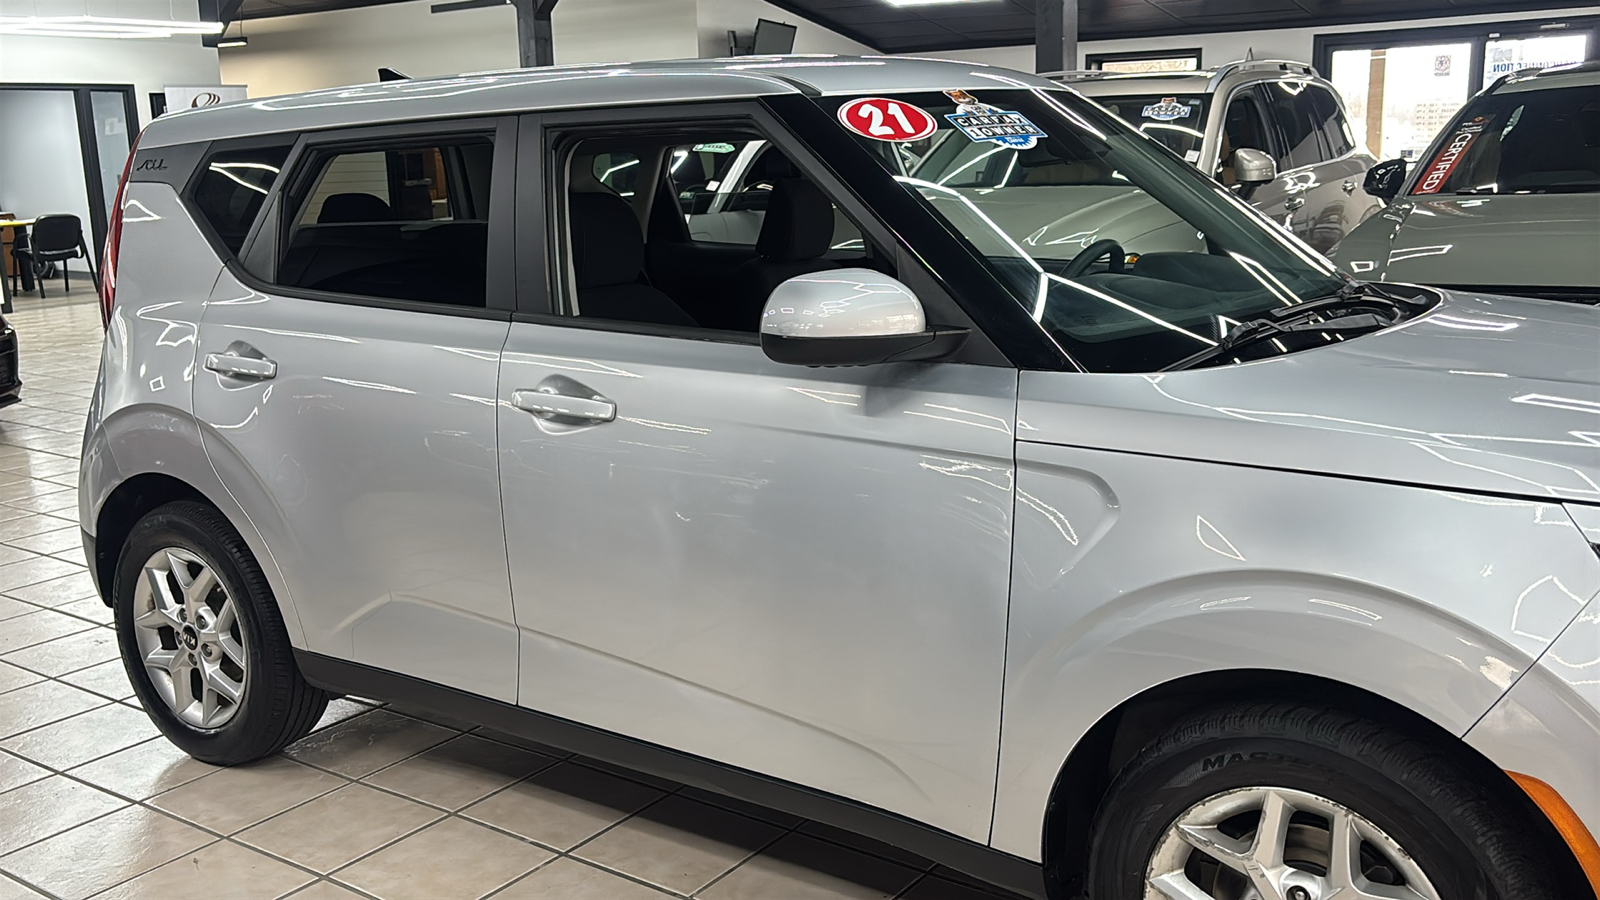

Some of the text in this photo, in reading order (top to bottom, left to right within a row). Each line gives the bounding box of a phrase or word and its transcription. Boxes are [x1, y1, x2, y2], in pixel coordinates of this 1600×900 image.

[858, 102, 915, 136] 21
[957, 115, 1026, 127] CARFAX
[1422, 133, 1473, 190] CERTIFIED
